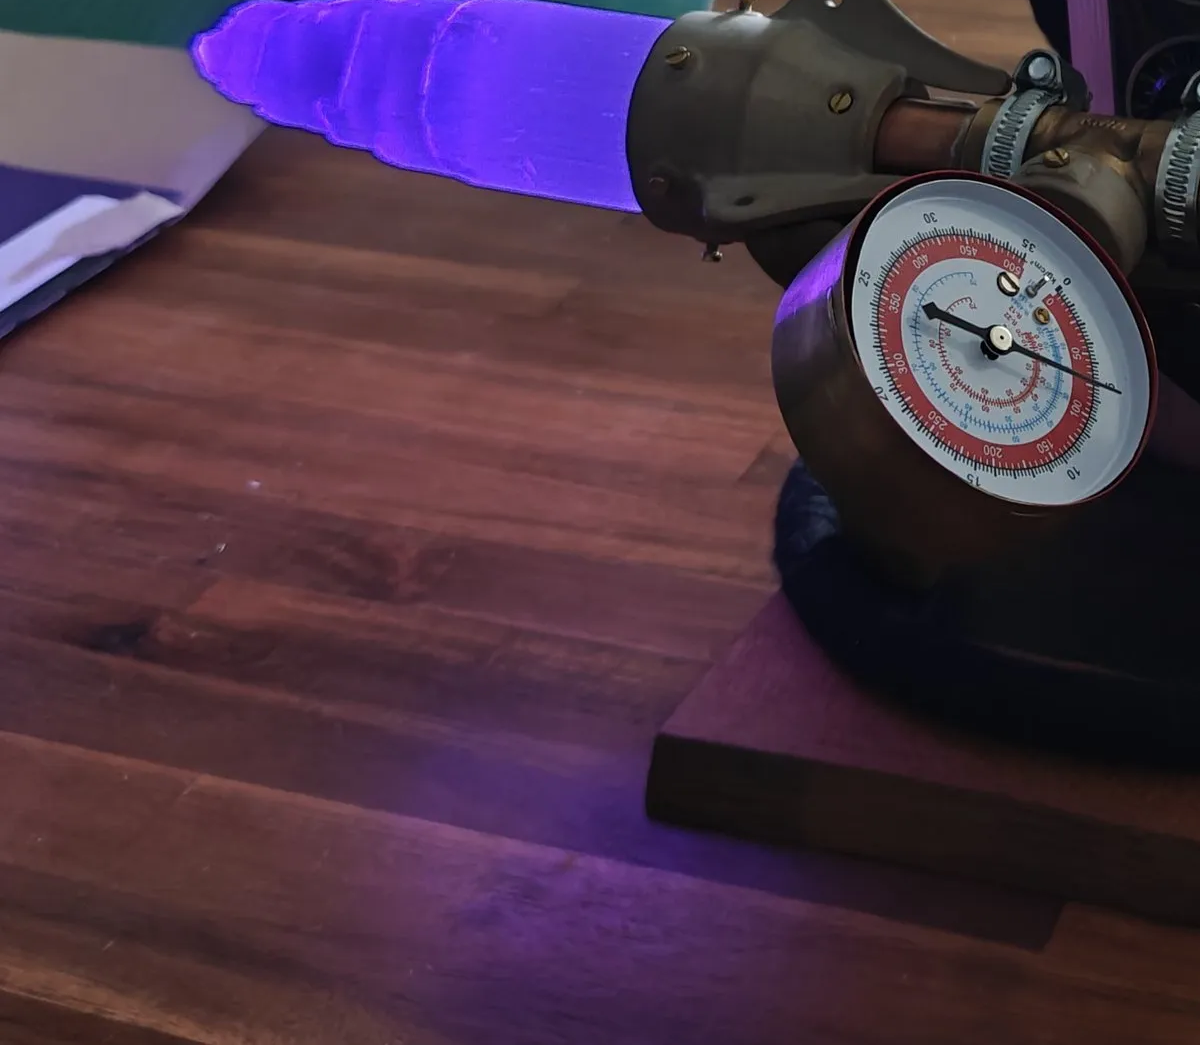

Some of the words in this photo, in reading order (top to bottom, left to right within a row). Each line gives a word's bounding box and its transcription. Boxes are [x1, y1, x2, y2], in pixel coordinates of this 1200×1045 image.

[923, 211, 938, 224] 30
[960, 245, 978, 257] 450
[1021, 238, 1036, 253] 35
[912, 253, 929, 269] 400
[1003, 259, 1021, 275] 500
[858, 269, 871, 287] 25
[1063, 277, 1071, 286] 0
[889, 292, 901, 314] 350
[1046, 298, 1054, 306] 0
[1072, 346, 1082, 360] 50
[893, 352, 907, 374] 300
[874, 386, 889, 401] 20
[1069, 399, 1083, 417] 100
[927, 411, 948, 431] 250
[983, 444, 1003, 458] 200
[1036, 439, 1054, 454] 150
[966, 473, 981, 487] 15
[1066, 466, 1081, 480] 10
